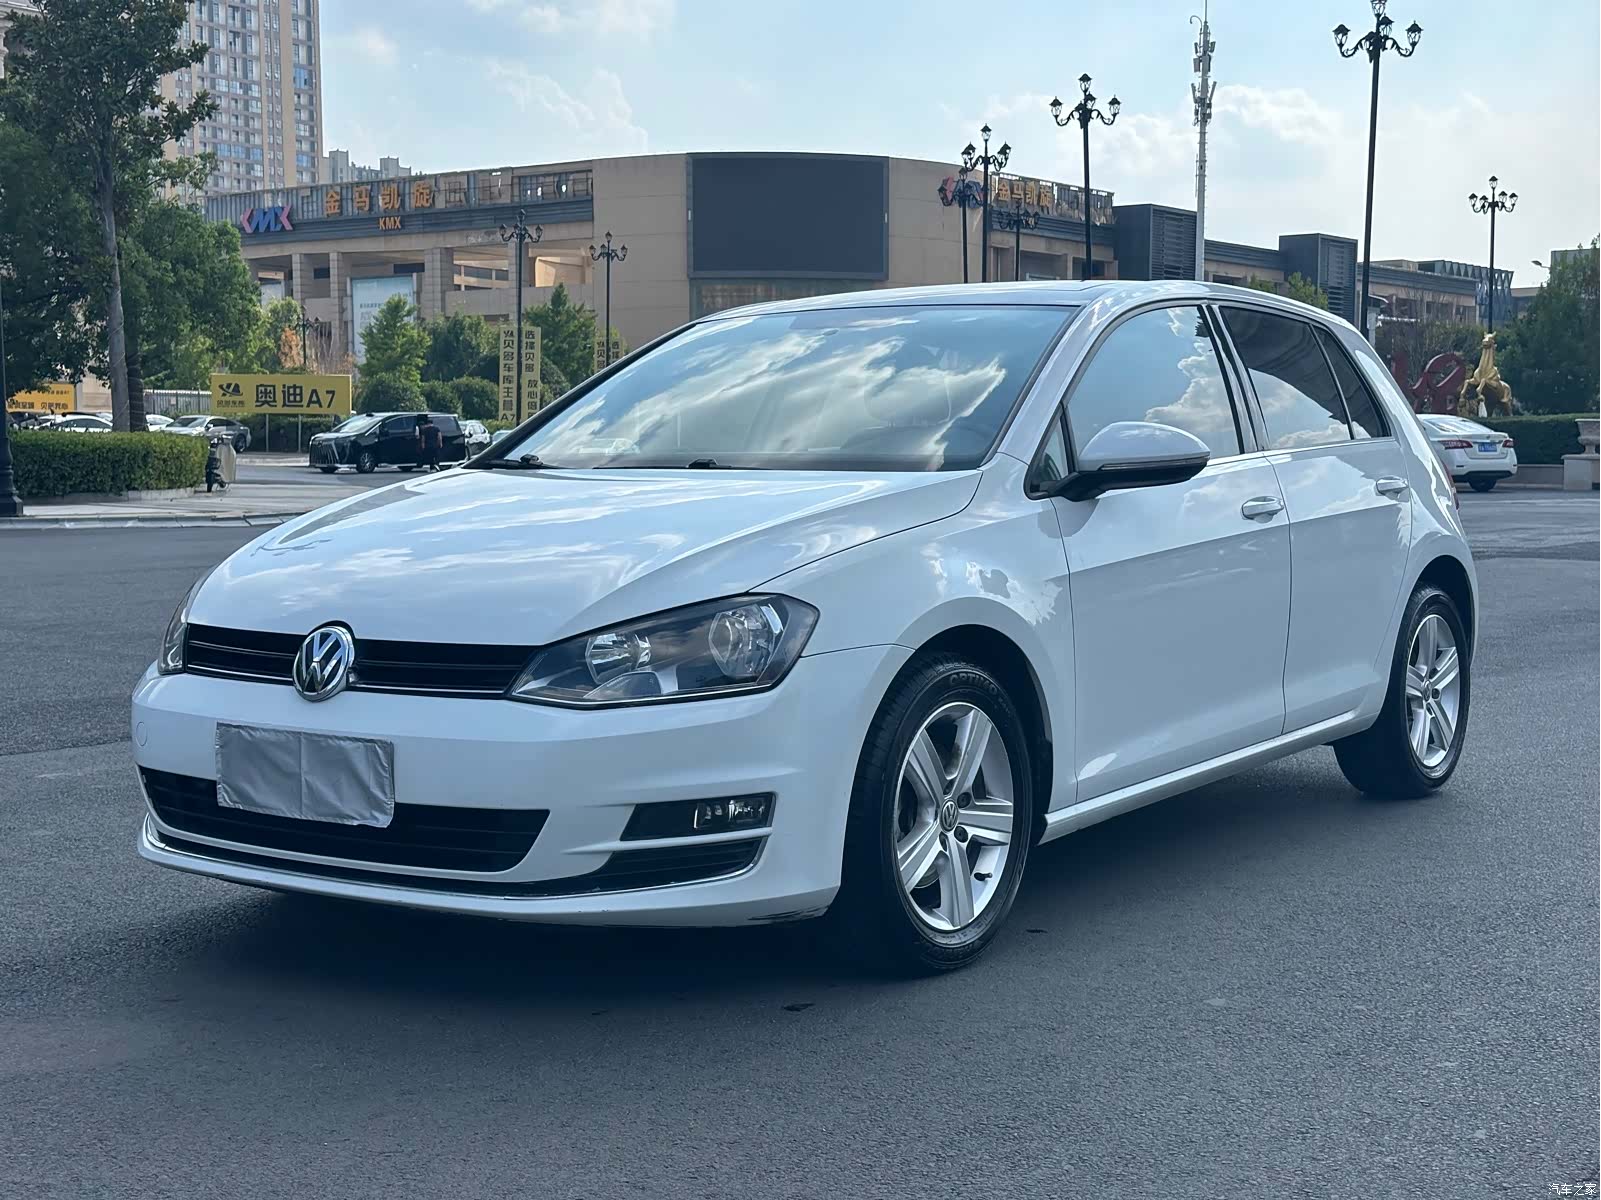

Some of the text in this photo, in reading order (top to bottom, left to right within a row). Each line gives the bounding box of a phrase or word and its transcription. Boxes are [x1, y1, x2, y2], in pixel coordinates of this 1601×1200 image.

[324, 180, 432, 214] 金马凯旋
[997, 180, 1052, 207] 金马凯旋
[378, 216, 402, 230] KMX
[255, 383, 337, 409] 奥迪A7
